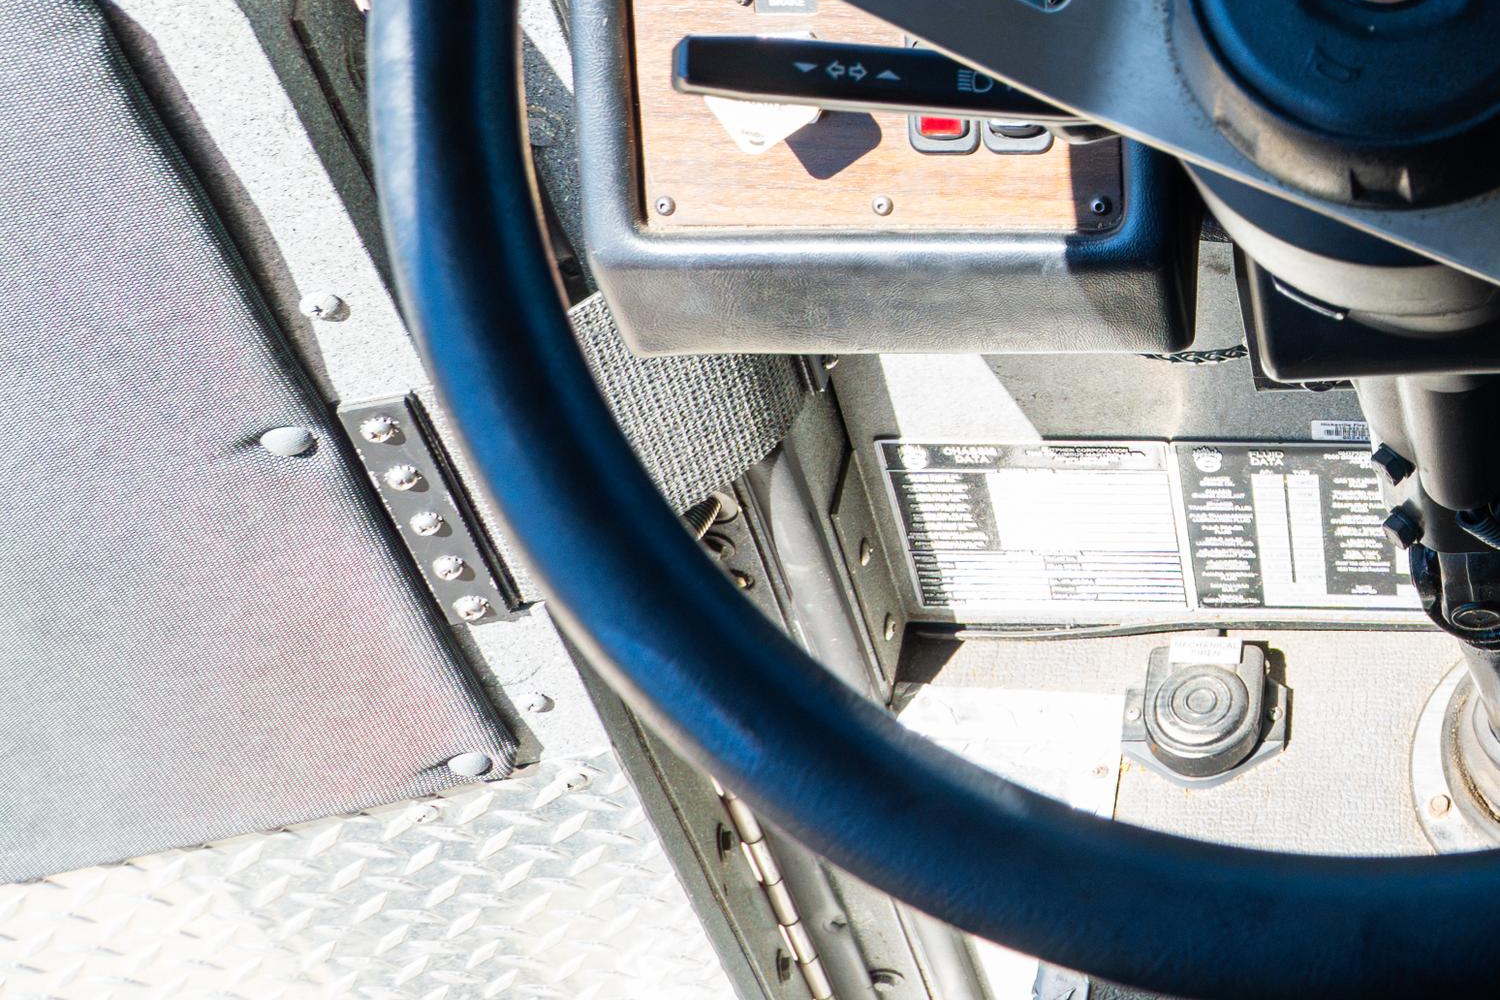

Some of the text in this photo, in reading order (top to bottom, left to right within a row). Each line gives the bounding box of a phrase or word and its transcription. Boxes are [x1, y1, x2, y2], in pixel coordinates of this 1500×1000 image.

[955, 454, 993, 464] DATA
[1249, 450, 1285, 459] FLUID
[1250, 457, 1285, 467] DATA
